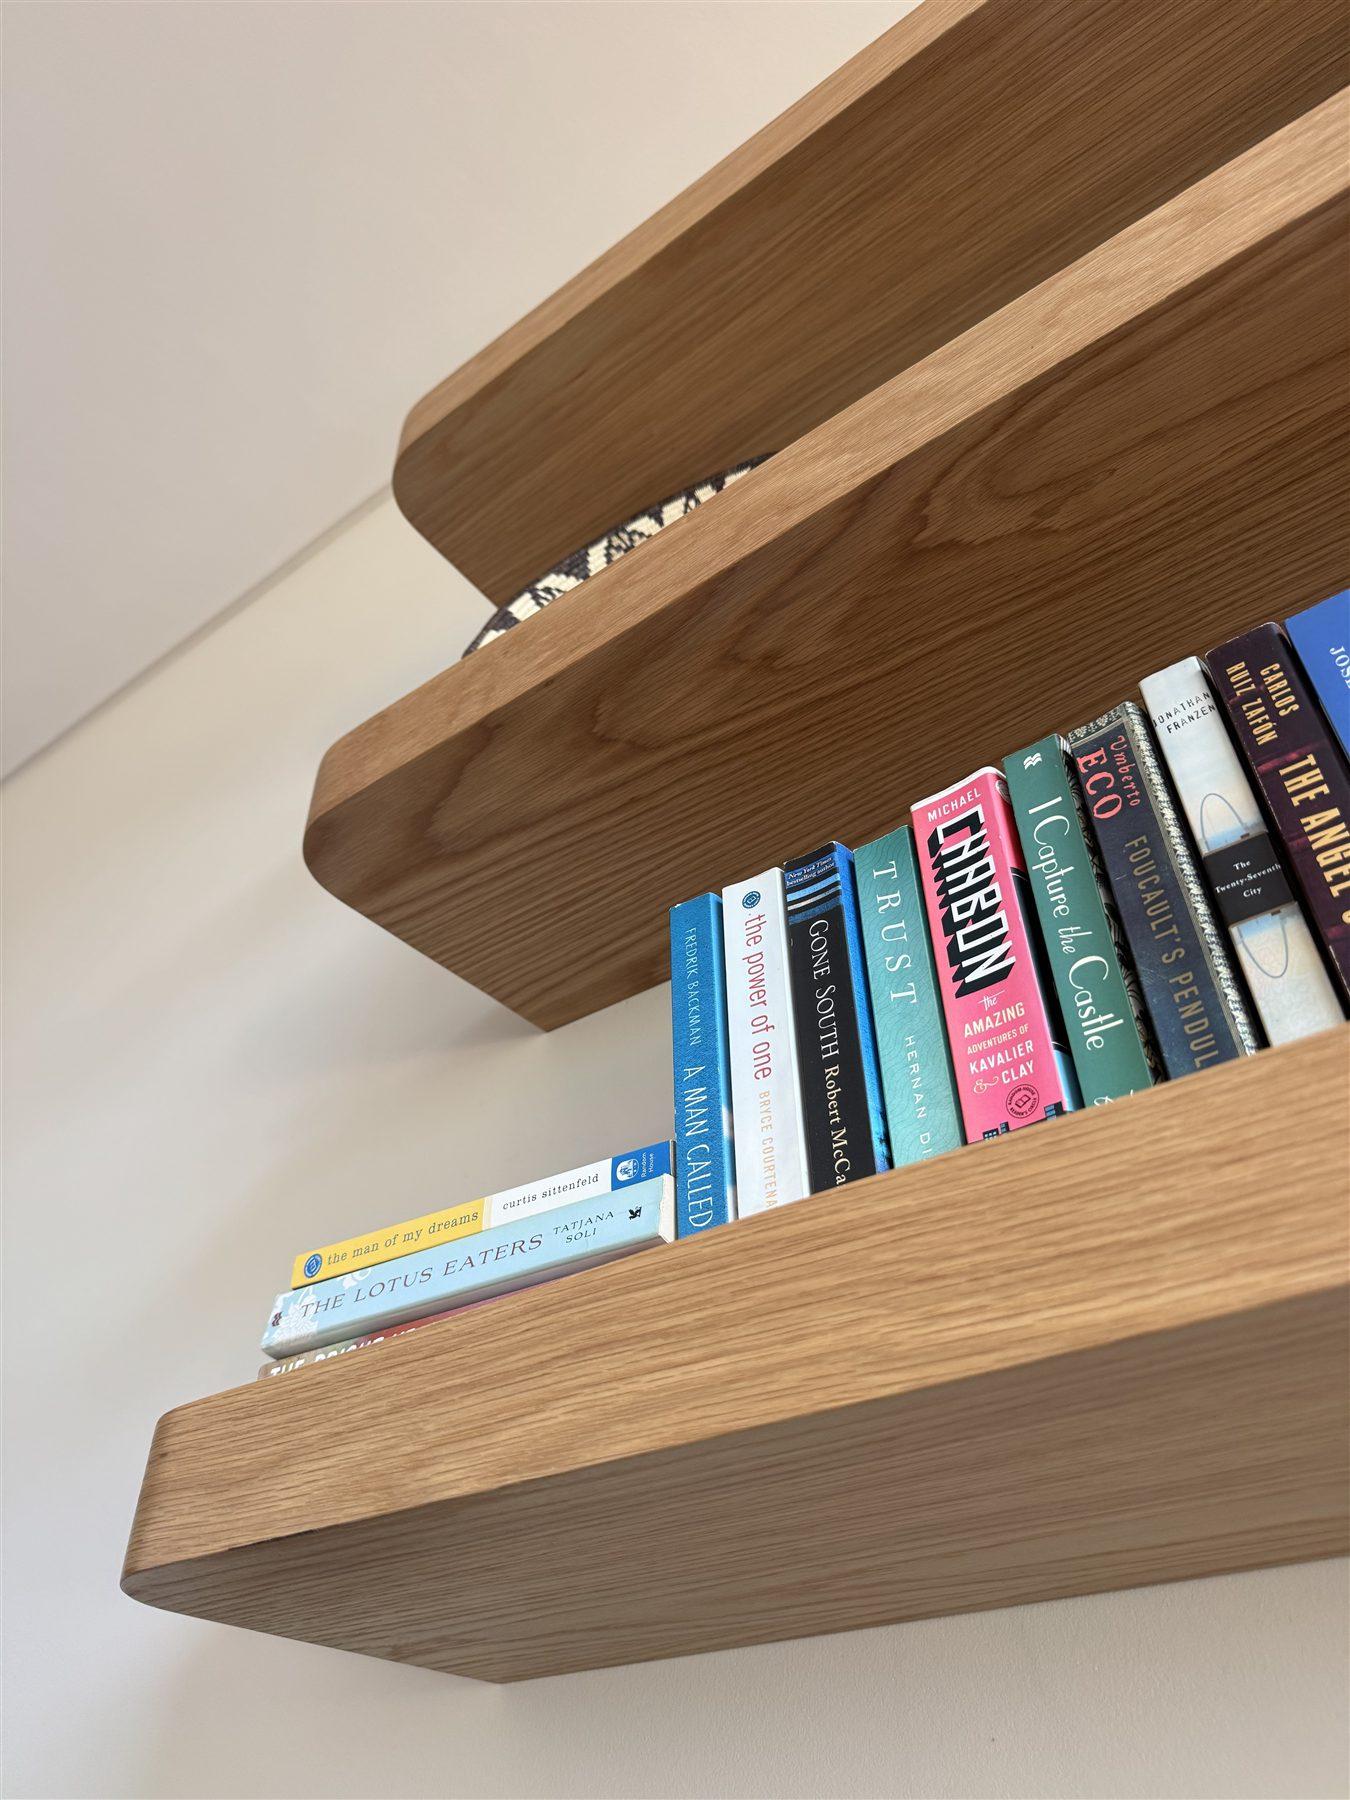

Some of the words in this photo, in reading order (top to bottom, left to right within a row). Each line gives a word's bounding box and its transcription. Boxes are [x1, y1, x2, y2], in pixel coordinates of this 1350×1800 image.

[1329, 646, 1350, 689] JOS
[1152, 691, 1210, 728] JONATHAN
[1226, 661, 1256, 697] RUIZ
[1242, 697, 1278, 746] ZAFÓN
[1260, 663, 1299, 716] CARLOS
[1166, 704, 1216, 734] FRANZEN
[1076, 747, 1122, 819] ECO
[1110, 735, 1140, 806] Umberto
[1279, 754, 1330, 807] THE
[927, 787, 981, 822] MICHAEL
[1028, 796, 1063, 815] I
[786, 871, 817, 886] bestselling
[817, 862, 834, 874] author
[788, 871, 802, 879] New
[803, 865, 815, 874] York
[816, 857, 832, 868] Times
[1032, 815, 1075, 918] Capture
[1215, 863, 1281, 894] Twenty-Seventh
[1233, 860, 1251, 870] The
[934, 803, 1016, 988] CHABON
[1243, 887, 1262, 898] City
[744, 913, 767, 947] the
[809, 919, 831, 980] GONE
[873, 860, 917, 1004] TRUST
[1058, 926, 1093, 955] the
[684, 927, 698, 980] FREDRIK
[1124, 835, 1185, 964] FOUCAULT'S
[1169, 971, 1219, 1069] PENDUL
[742, 951, 767, 1008] power
[978, 990, 1005, 1012] the
[687, 980, 702, 1047] BACKMAN
[750, 1014, 775, 1035] of
[815, 984, 840, 1060] SOUTH
[964, 1002, 1025, 1038] AMAZING
[1069, 955, 1124, 1051] Castle
[752, 1041, 772, 1080] one
[967, 1029, 1017, 1055] ADVENTURES
[1019, 1023, 1029, 1035] OF
[969, 1039, 1034, 1075] KAVALIER
[683, 1065, 706, 1081] A
[824, 1064, 842, 1125] Robert
[905, 1035, 927, 1119] HERNAN
[973, 1076, 999, 1094] &
[1002, 1060, 1034, 1084] CLAY
[684, 1087, 709, 1137] MAN
[759, 1090, 773, 1133] BRYCE
[503, 1193, 536, 1210] curtis
[542, 1174, 599, 1199] sittenfeld
[686, 1144, 714, 1227] CALLED
[327, 1251, 347, 1266] the
[352, 1242, 379, 1258] man
[384, 1234, 399, 1248] of
[402, 1228, 423, 1243] my
[428, 1212, 479, 1235] dreams
[553, 1211, 615, 1235] TATJANA
[565, 1227, 597, 1244] SOLI
[301, 1293, 345, 1318] THE
[354, 1267, 433, 1303] LOTUS
[443, 1234, 544, 1277] EATERS
